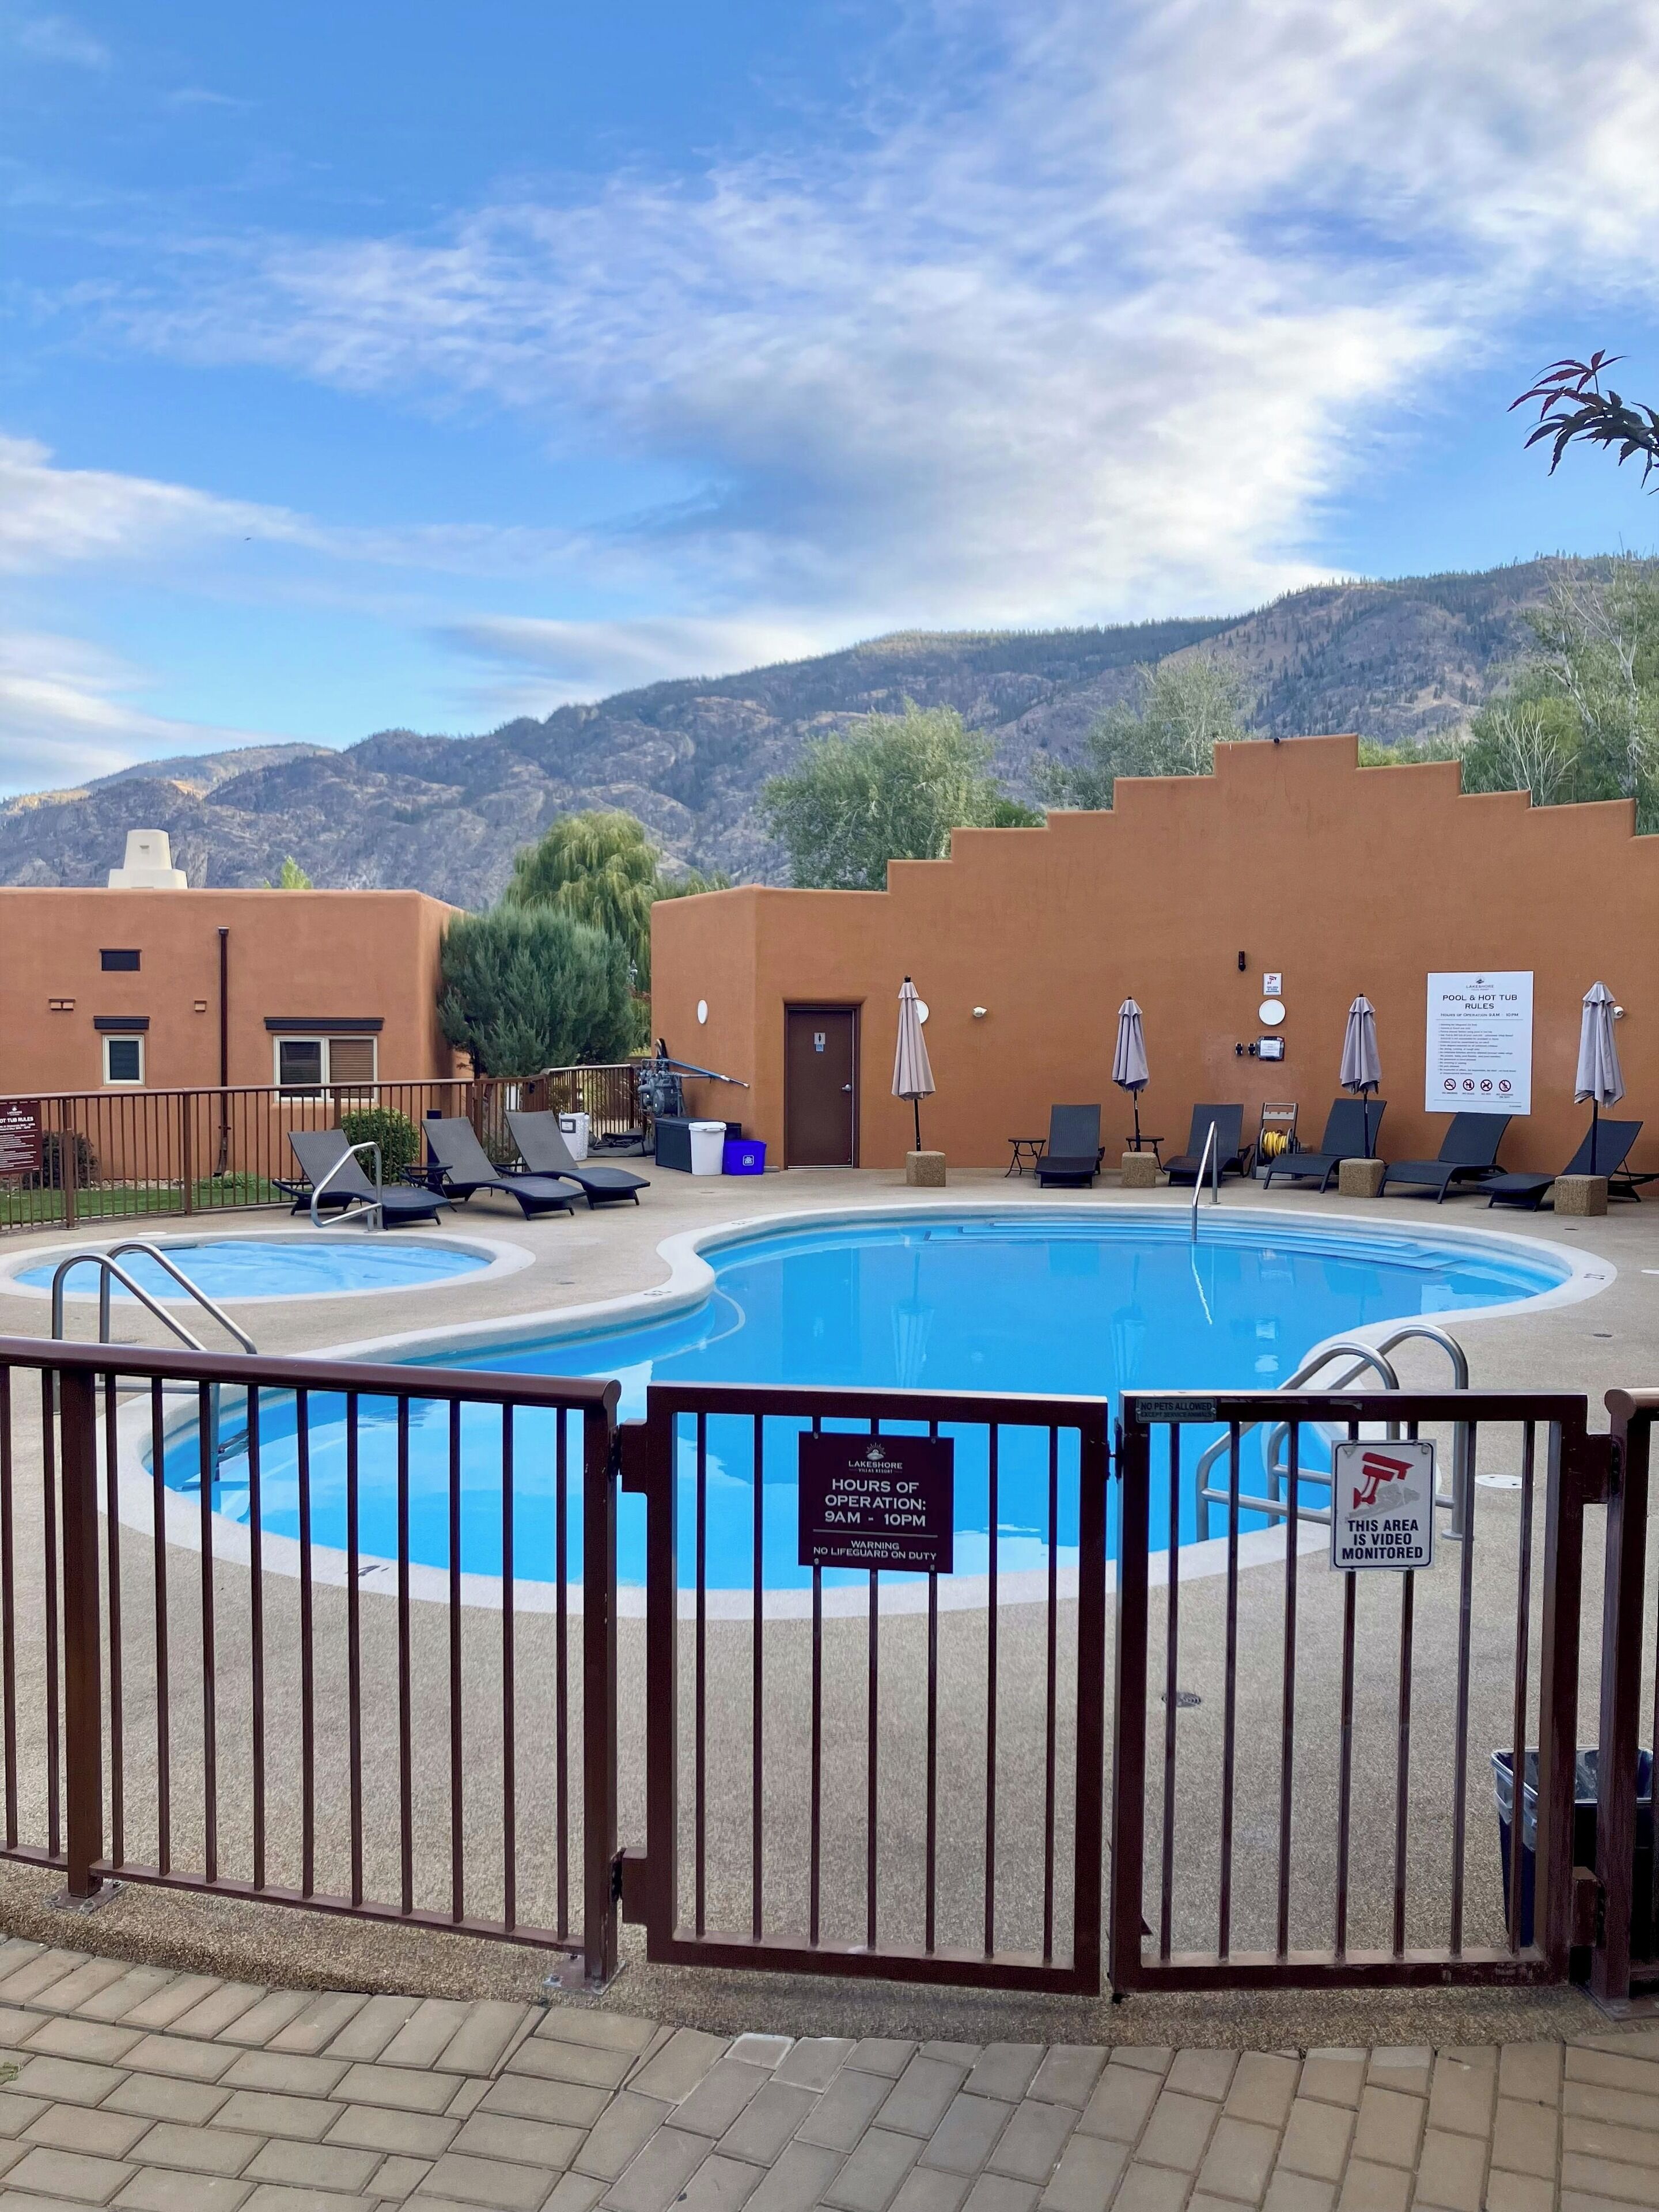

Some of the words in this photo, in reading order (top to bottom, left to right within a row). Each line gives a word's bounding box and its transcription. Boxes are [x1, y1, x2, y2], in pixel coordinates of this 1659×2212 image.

[1141, 1402, 1152, 1410] NO
[1154, 1402, 1173, 1410] PETS
[1175, 1402, 1212, 1410] ALLOWED
[849, 1460, 903, 1469] LAKESHORE
[832, 1478, 891, 1493] HOURS
[896, 1482, 919, 1494] OF
[825, 1494, 926, 1510] OPERATION:
[825, 1510, 861, 1524] 9AM
[884, 1514, 926, 1527] 10PM
[1348, 1520, 1378, 1532] THIS
[1383, 1519, 1419, 1532] AREA
[851, 1540, 900, 1551] WARNING
[1354, 1533, 1366, 1546] IS
[1370, 1533, 1412, 1546] VIDEO
[813, 1547, 828, 1555] NO
[831, 1548, 888, 1558] LIFEGUARD
[891, 1551, 906, 1559] ON
[909, 1552, 937, 1560] DUTY
[1342, 1546, 1423, 1560] MONITORED
